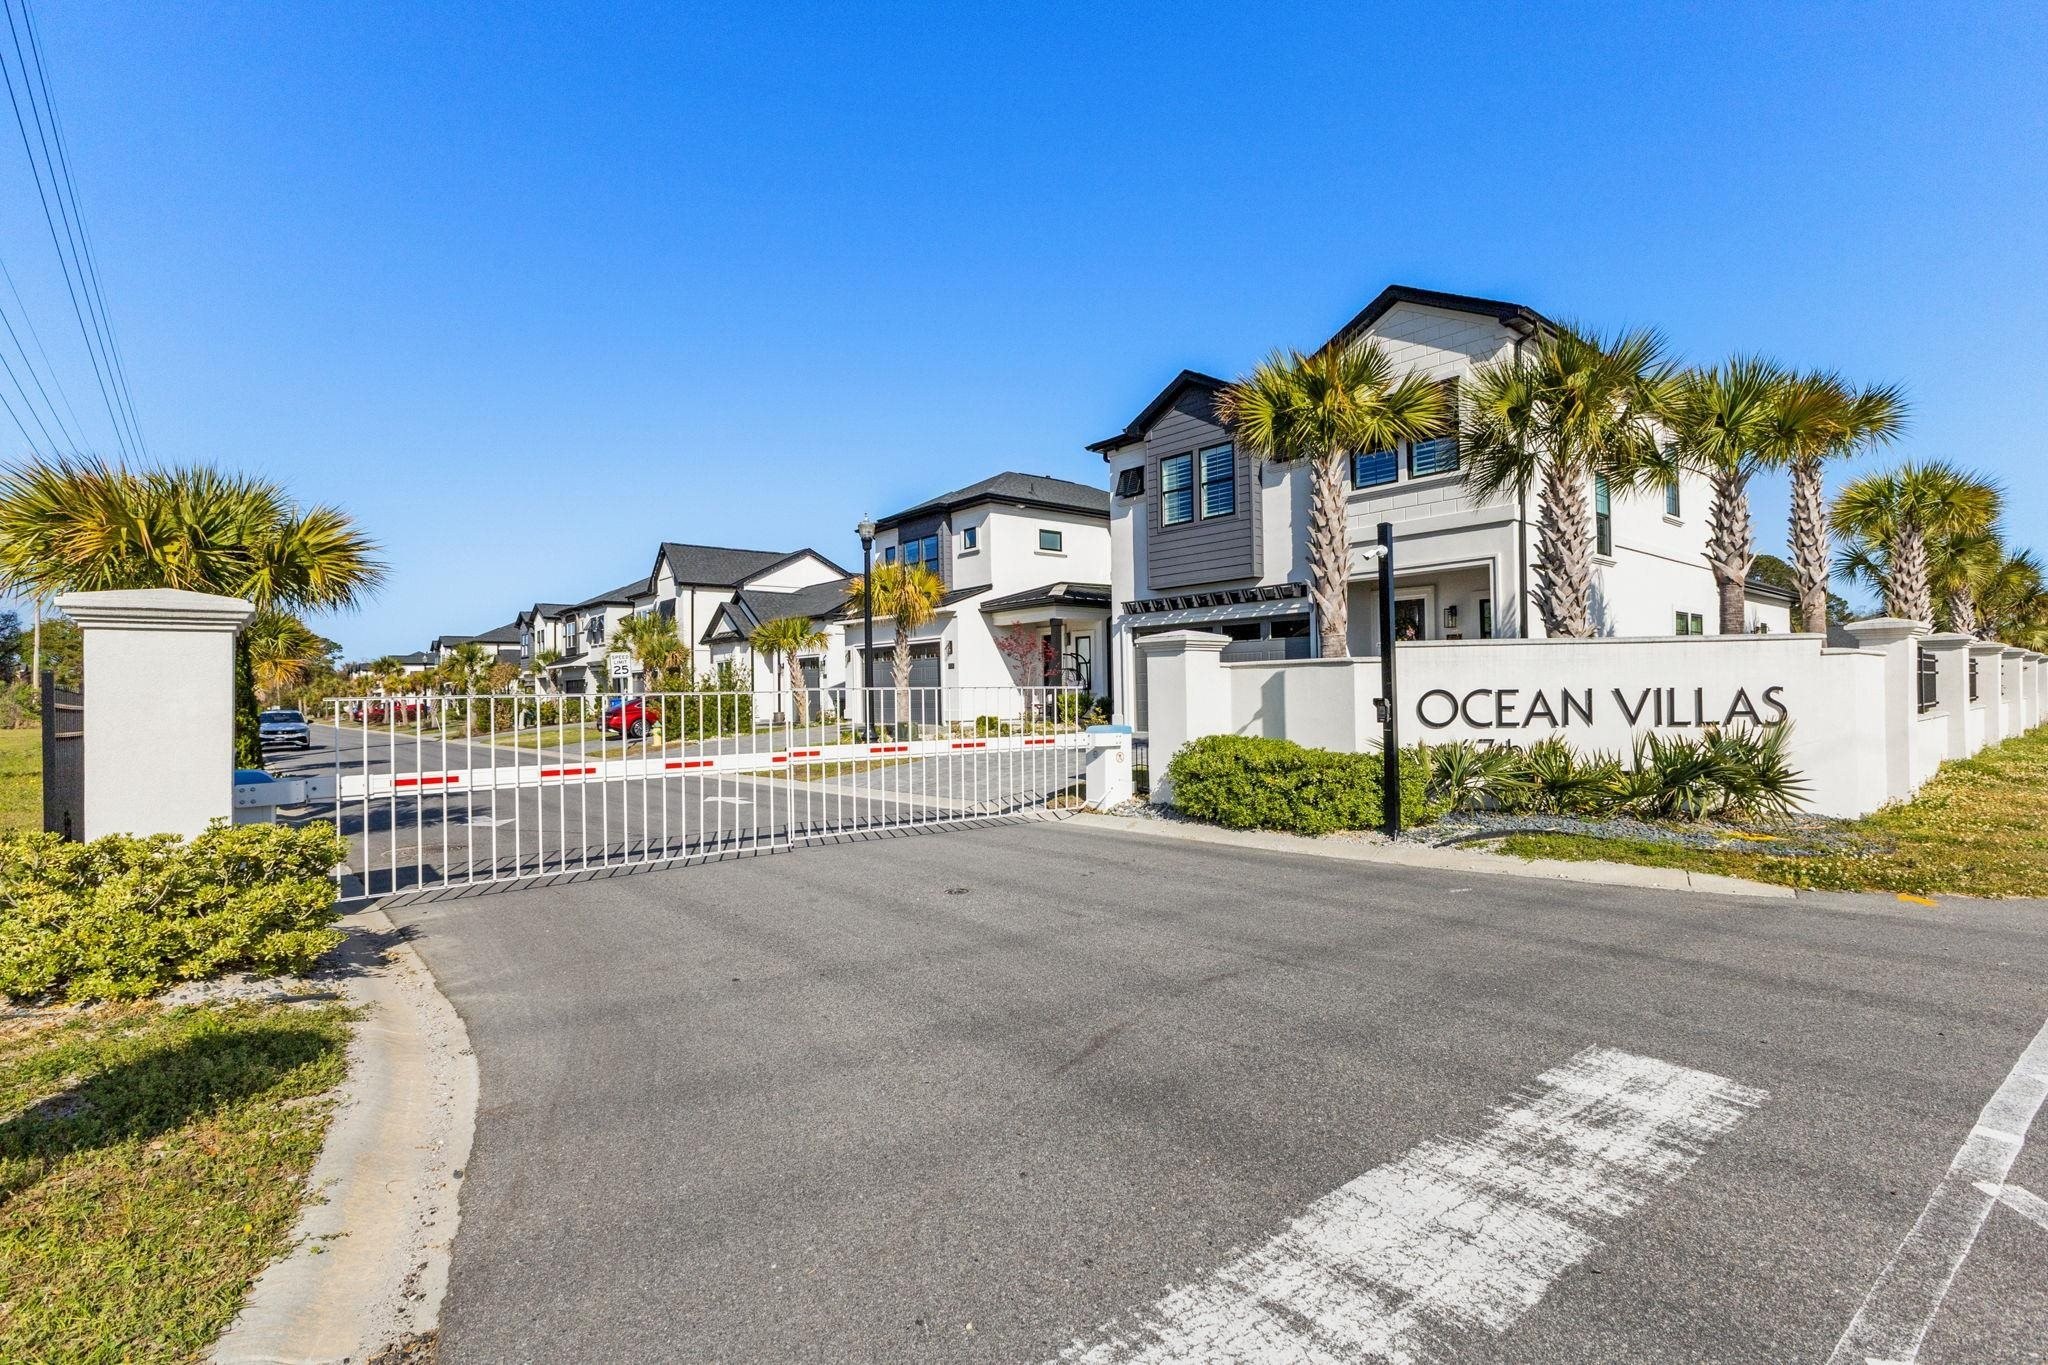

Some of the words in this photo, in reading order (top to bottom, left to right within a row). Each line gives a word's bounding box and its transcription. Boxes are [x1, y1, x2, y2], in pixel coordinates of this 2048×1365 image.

[614, 666, 629, 674] 25
[1416, 687, 1593, 730] OCEAN
[1611, 686, 1788, 729] VILLAS
